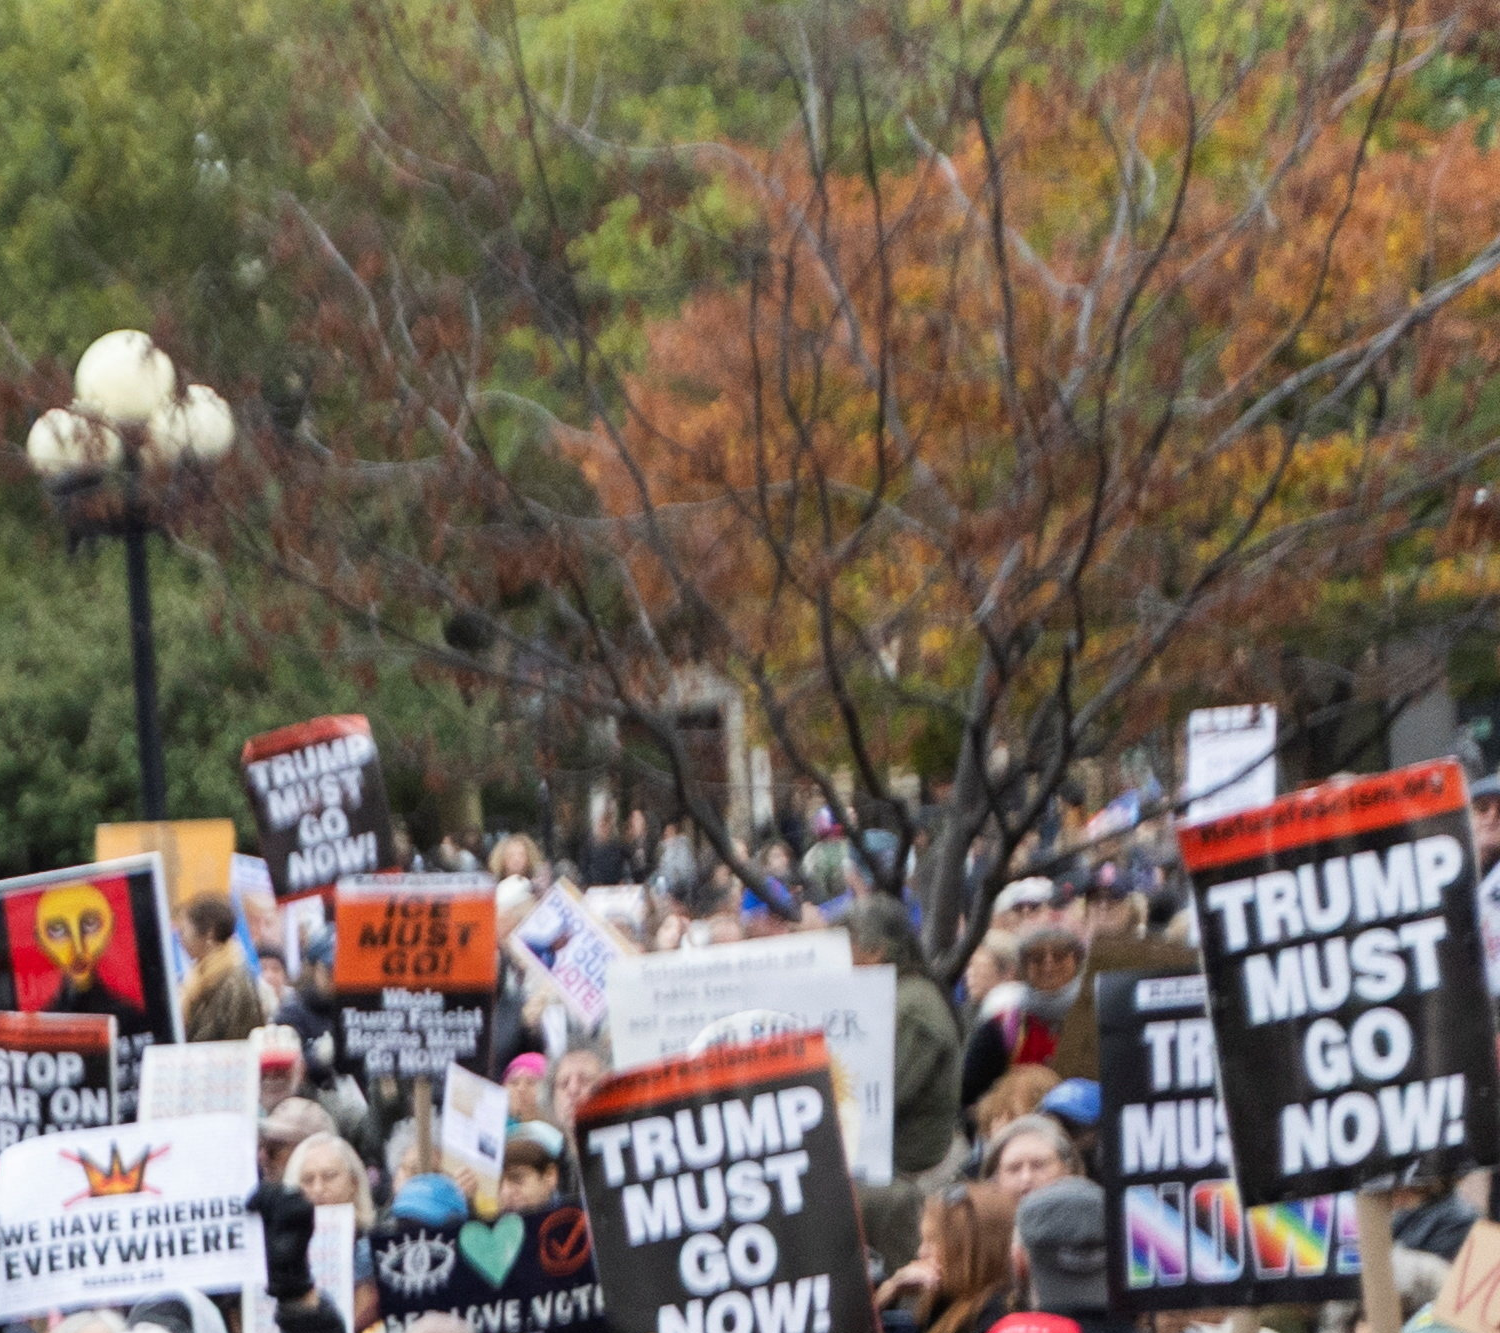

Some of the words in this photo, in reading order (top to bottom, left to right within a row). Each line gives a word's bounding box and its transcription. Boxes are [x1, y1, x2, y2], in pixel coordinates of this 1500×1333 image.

[247, 733, 378, 793] TRUMP
[266, 766, 366, 831] MUST
[298, 806, 351, 845] GO
[287, 831, 380, 890] NOW!
[1207, 834, 1464, 953] TRUMP
[358, 920, 481, 950] MUST
[381, 952, 455, 977] GO!
[382, 986, 445, 1008] Whole
[1242, 915, 1448, 1029] MUST
[342, 1007, 402, 1031] Trump
[408, 1006, 485, 1030] Fascist
[1303, 1006, 1413, 1091] GO
[51, 1086, 111, 1124] ON
[1280, 1072, 1466, 1176] NOW!
[588, 1084, 824, 1188] TRUMP
[1, 1222, 48, 1247] WE
[50, 1209, 122, 1239] HAVE
[130, 1195, 246, 1230] FRIENDS
[622, 1151, 810, 1248] MUST
[3, 1221, 246, 1282] EVERYWHERE
[678, 1222, 780, 1297] GO
